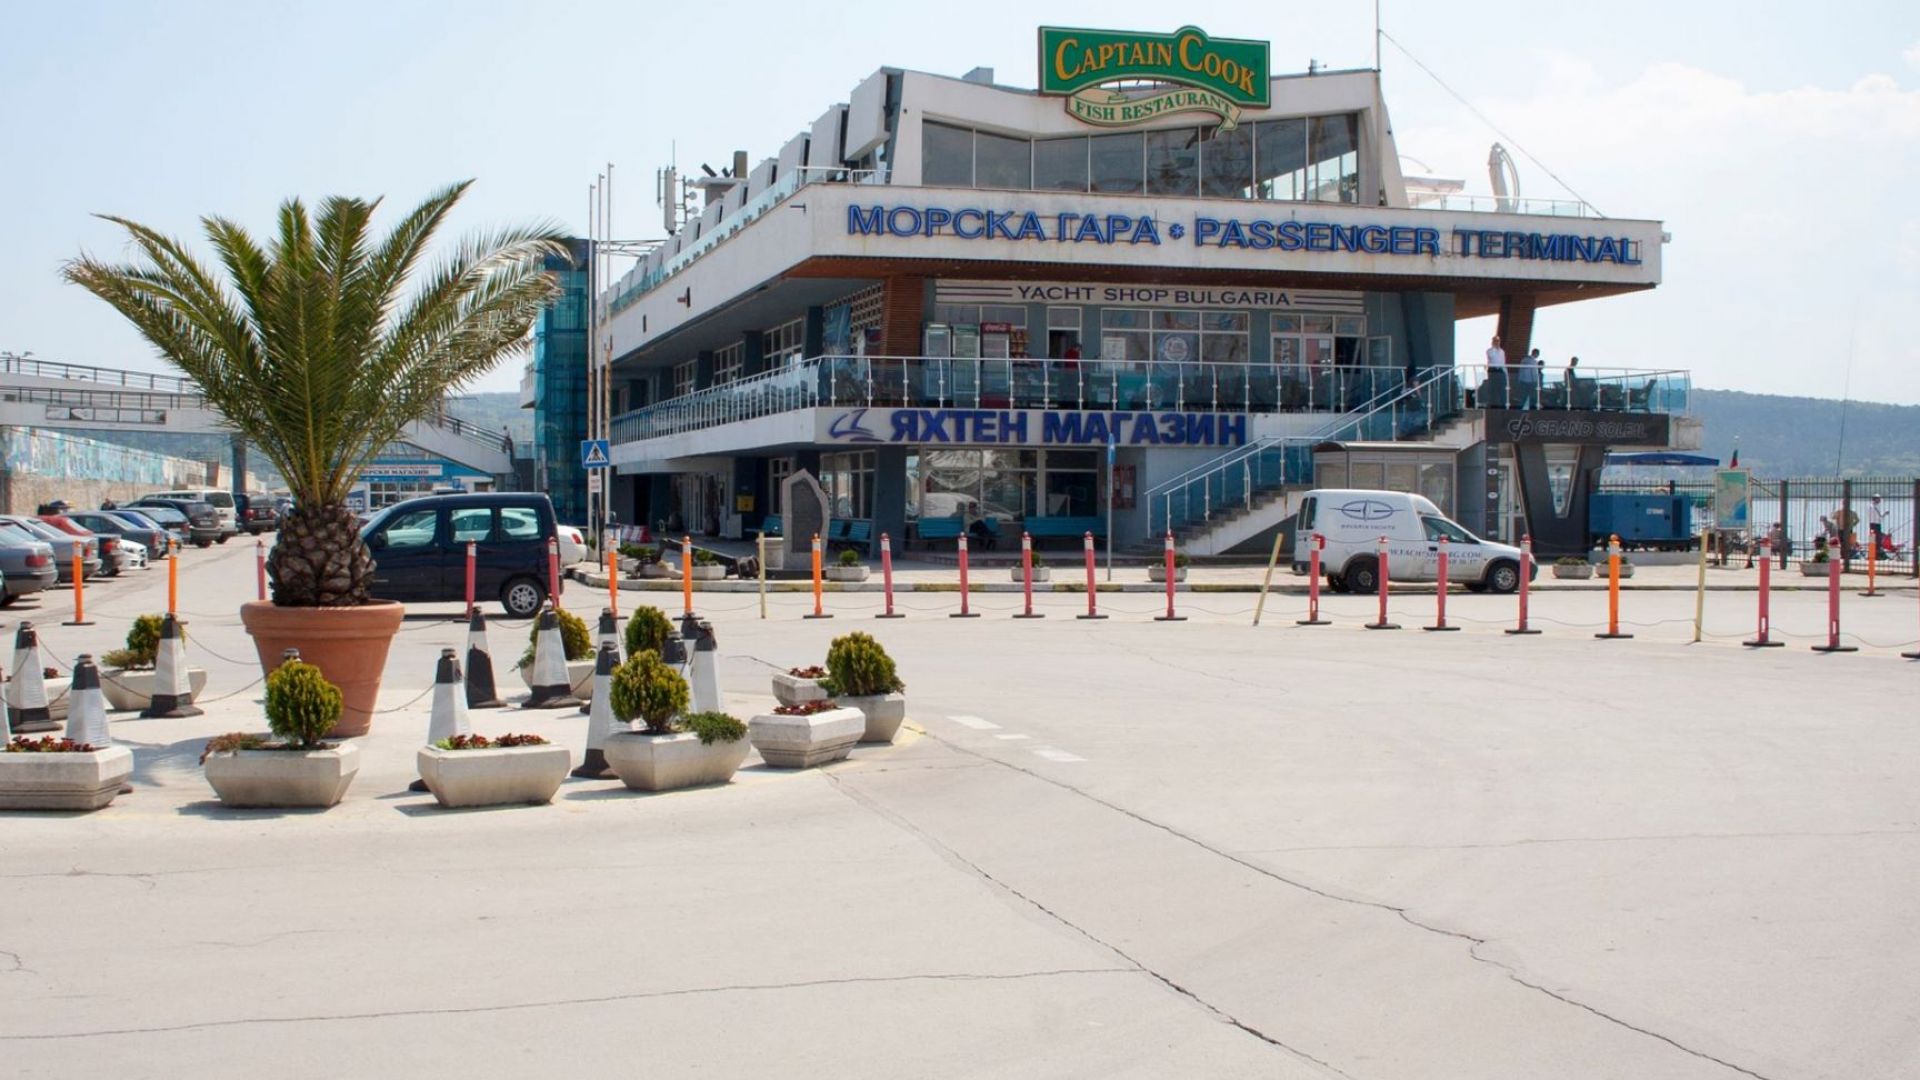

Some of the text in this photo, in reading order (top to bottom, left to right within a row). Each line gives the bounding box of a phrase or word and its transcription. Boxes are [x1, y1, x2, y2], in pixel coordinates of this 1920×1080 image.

[1055, 35, 1256, 95] CAPTAIN COOK
[1075, 93, 1232, 120] FISH RESTAURANT
[848, 204, 1642, 265] МОРСКА ГАРА PASSENGER TERMINAL
[1018, 286, 1290, 306] YACHT SHOP BULGARIA
[890, 409, 1247, 446] ЯХТЕН МАГАЗИН
[1535, 420, 1648, 439] GRAND SOLEIL
